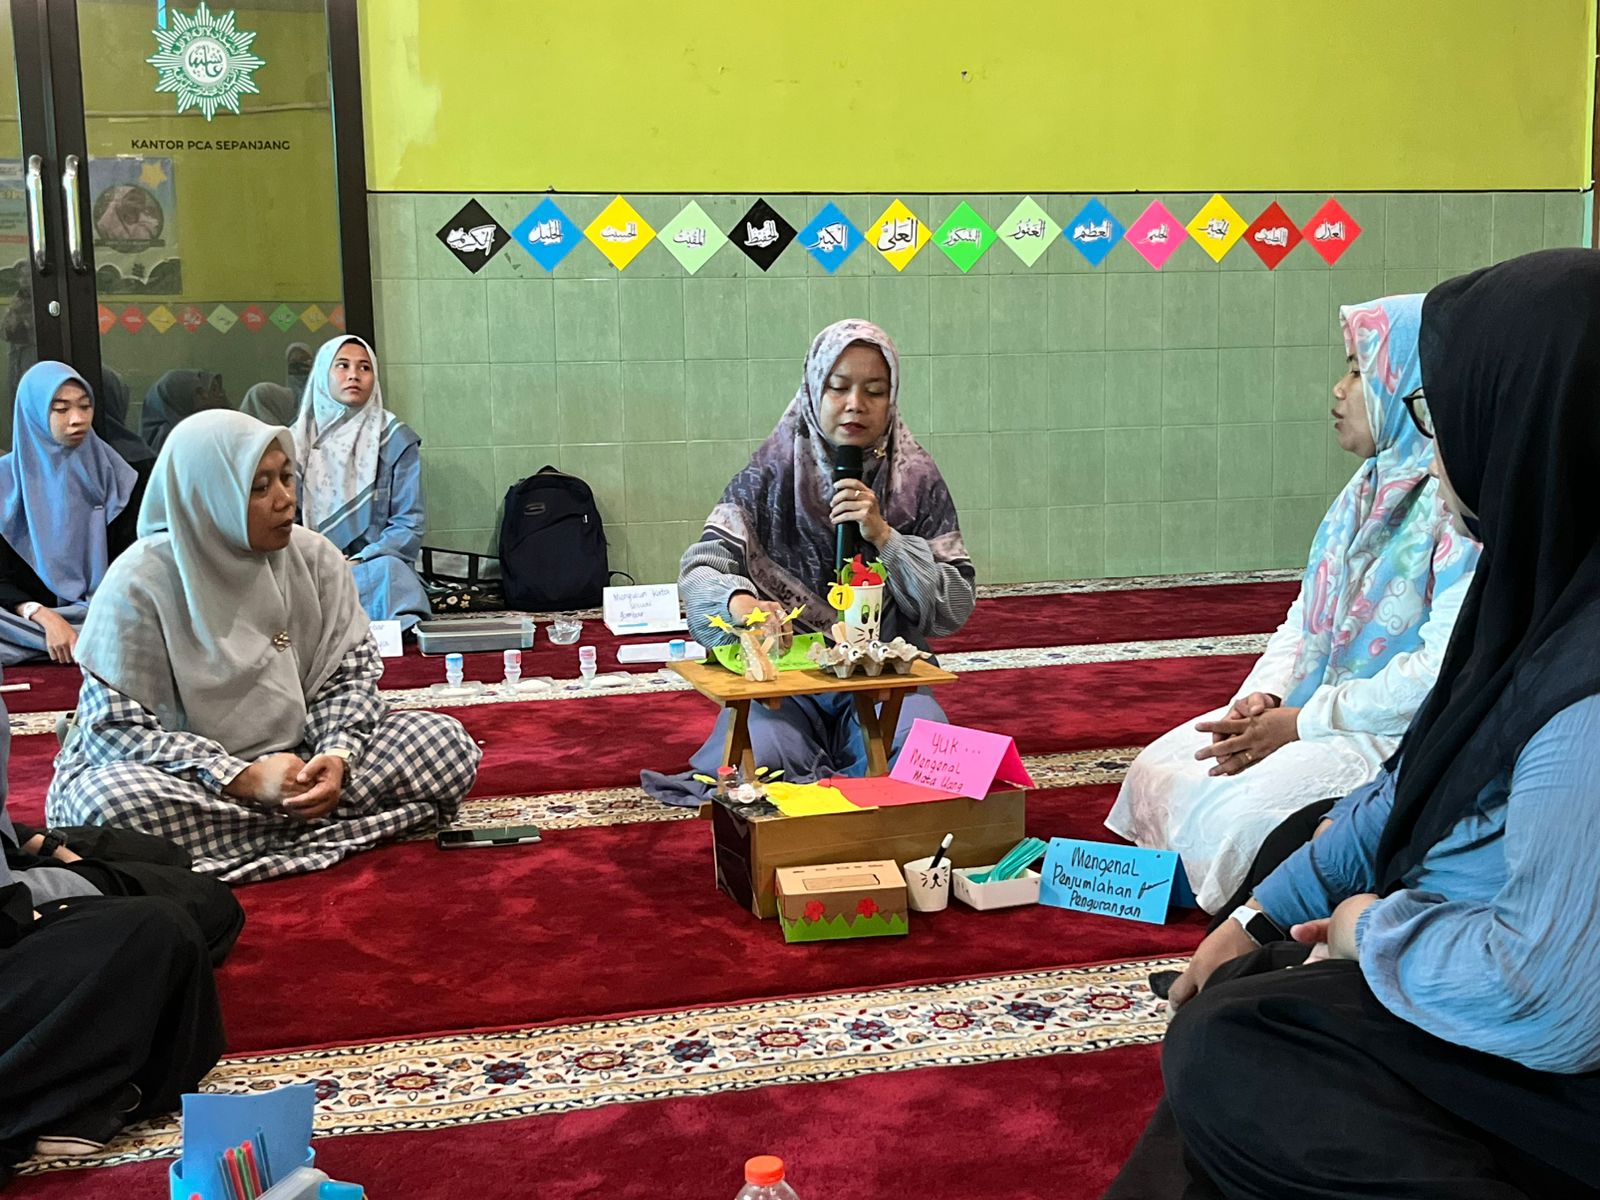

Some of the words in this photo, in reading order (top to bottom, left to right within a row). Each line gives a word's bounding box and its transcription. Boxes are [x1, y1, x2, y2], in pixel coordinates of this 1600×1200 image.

[131, 139, 184, 150] KANTOR
[188, 140, 213, 150] PCA
[216, 140, 291, 150] SEPANJANG
[1052, 862, 1132, 899] Penjumlahan
[1069, 889, 1141, 918] Pengurangan
